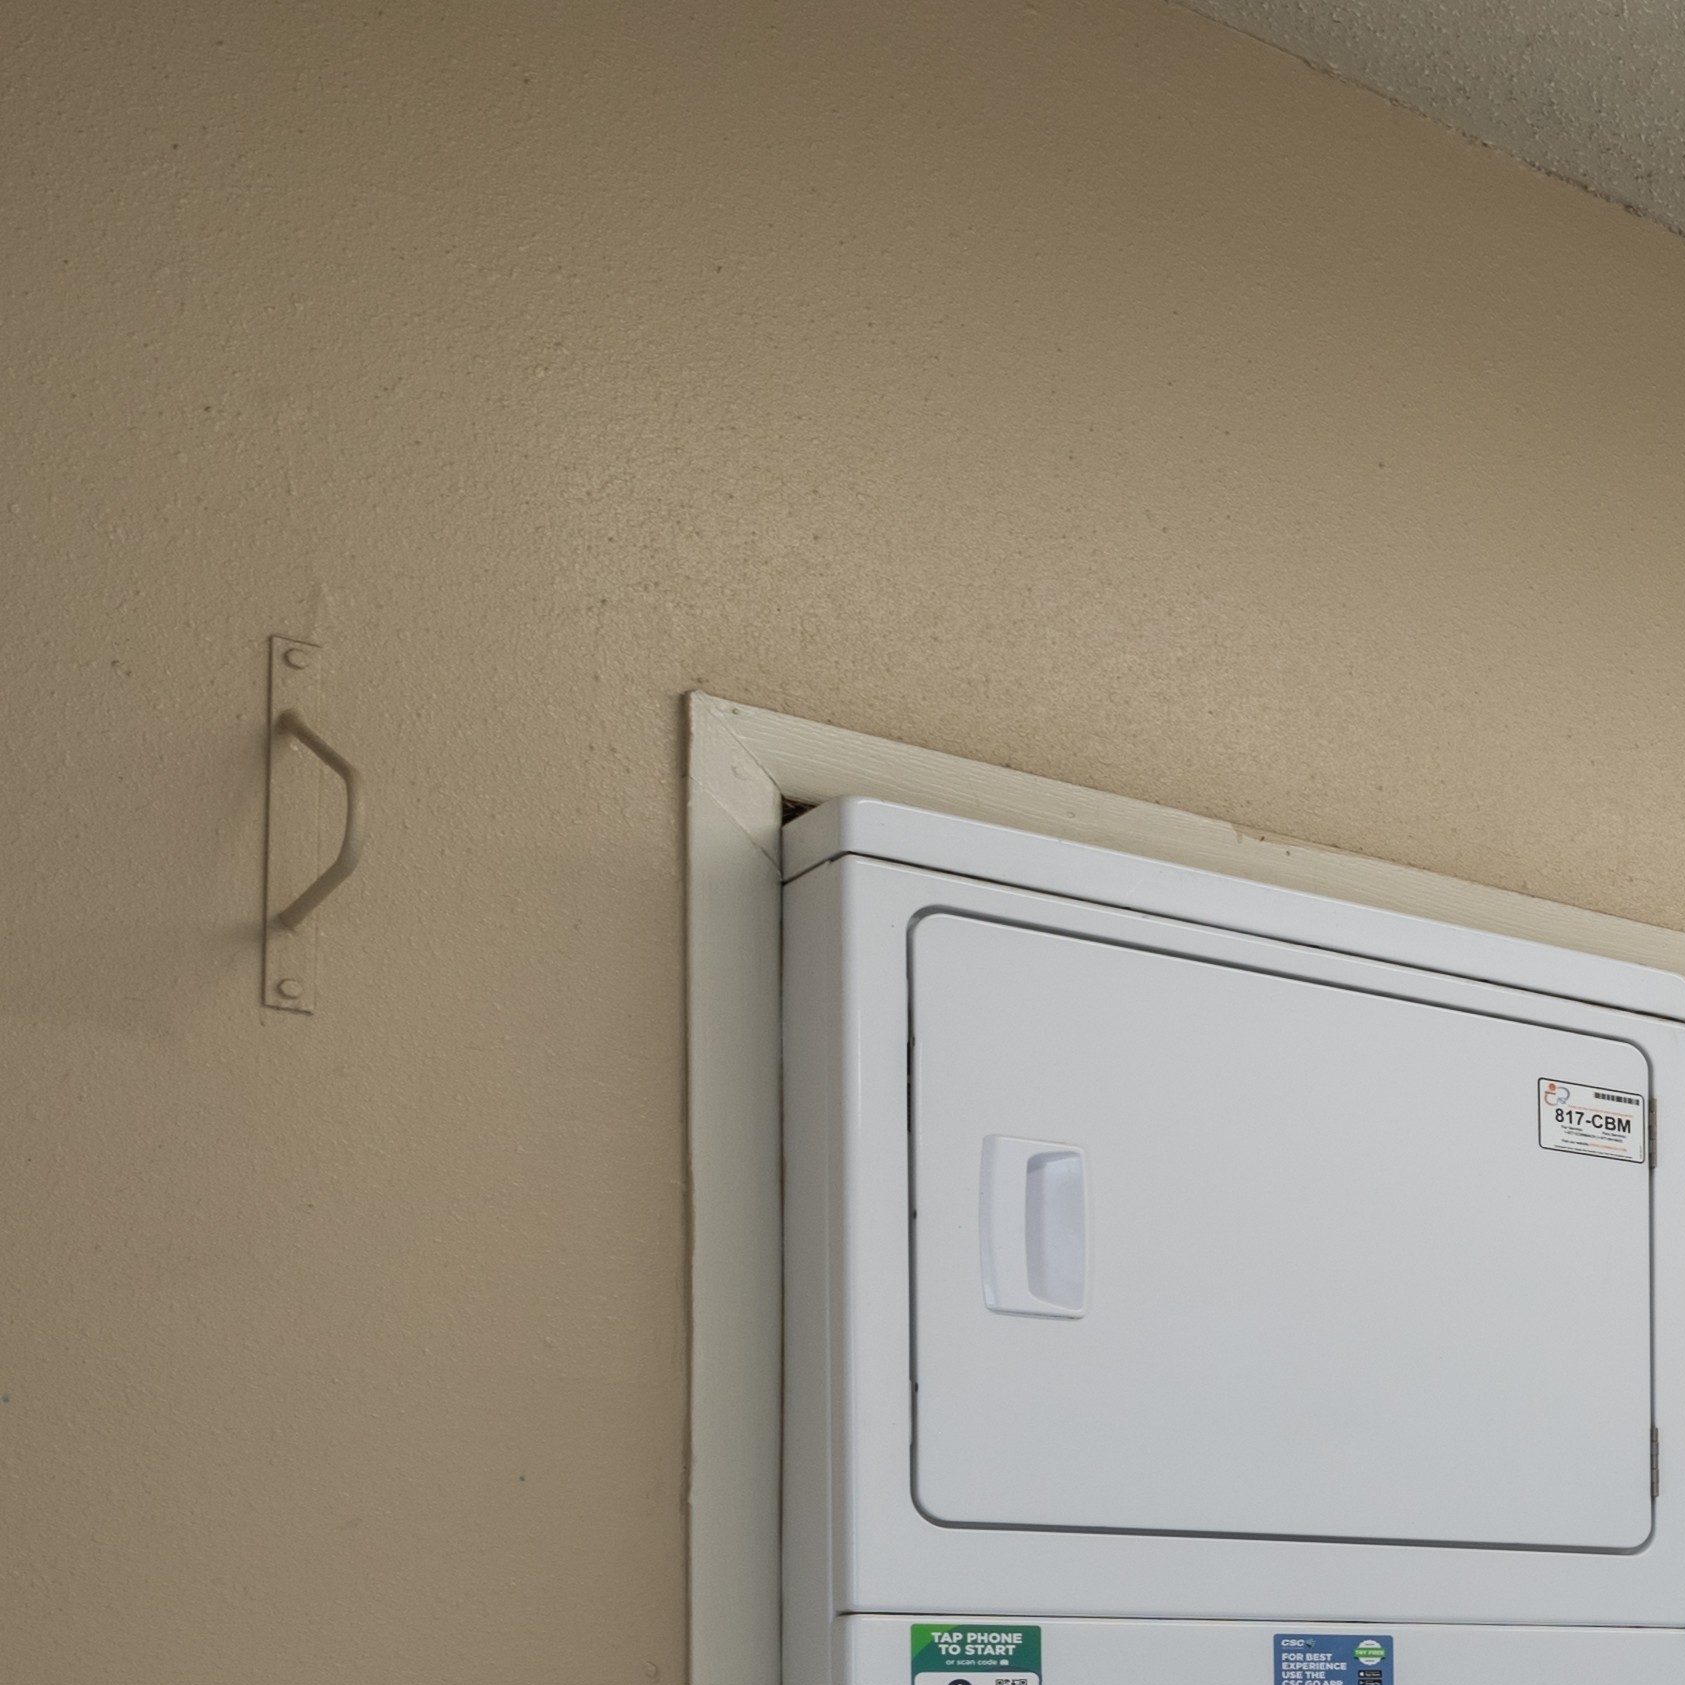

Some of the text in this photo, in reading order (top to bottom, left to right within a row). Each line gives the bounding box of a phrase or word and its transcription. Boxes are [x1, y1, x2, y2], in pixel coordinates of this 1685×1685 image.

[1555, 1108, 1631, 1133] 817-CBM
[931, 1632, 1023, 1643] TAP PHONE
[939, 1644, 1015, 1655] TO START
[1282, 1653, 1332, 1661] FOR BEST
[1282, 1662, 1347, 1670] EXPERIENCE
[1282, 1671, 1325, 1679] USE THE
